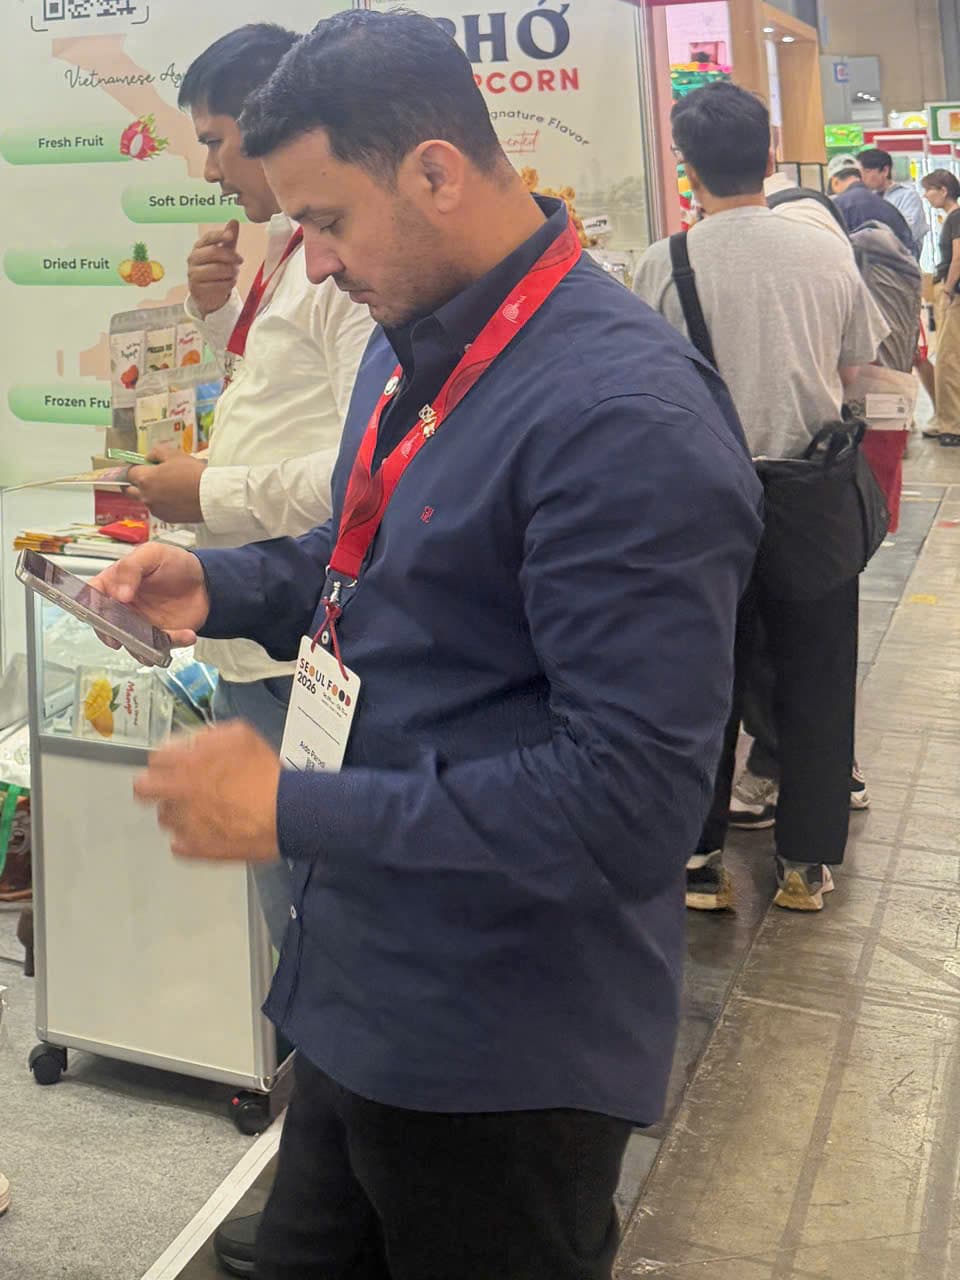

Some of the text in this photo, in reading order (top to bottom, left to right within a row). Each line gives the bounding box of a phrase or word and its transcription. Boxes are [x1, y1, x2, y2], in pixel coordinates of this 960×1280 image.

[65, 65, 155, 88] Vietnamese
[473, 68, 579, 94] CORN
[490, 110, 590, 146] gnature Flavor
[38, 135, 104, 149] Fresh Fruit
[149, 194, 239, 207] Soft Dried Fru
[43, 258, 110, 270] Dried Fruit
[44, 395, 112, 409] Frozen Fru
[297, 671, 316, 695] 2026
[300, 658, 325, 687] SEOUL
[327, 679, 352, 707] FOOD
